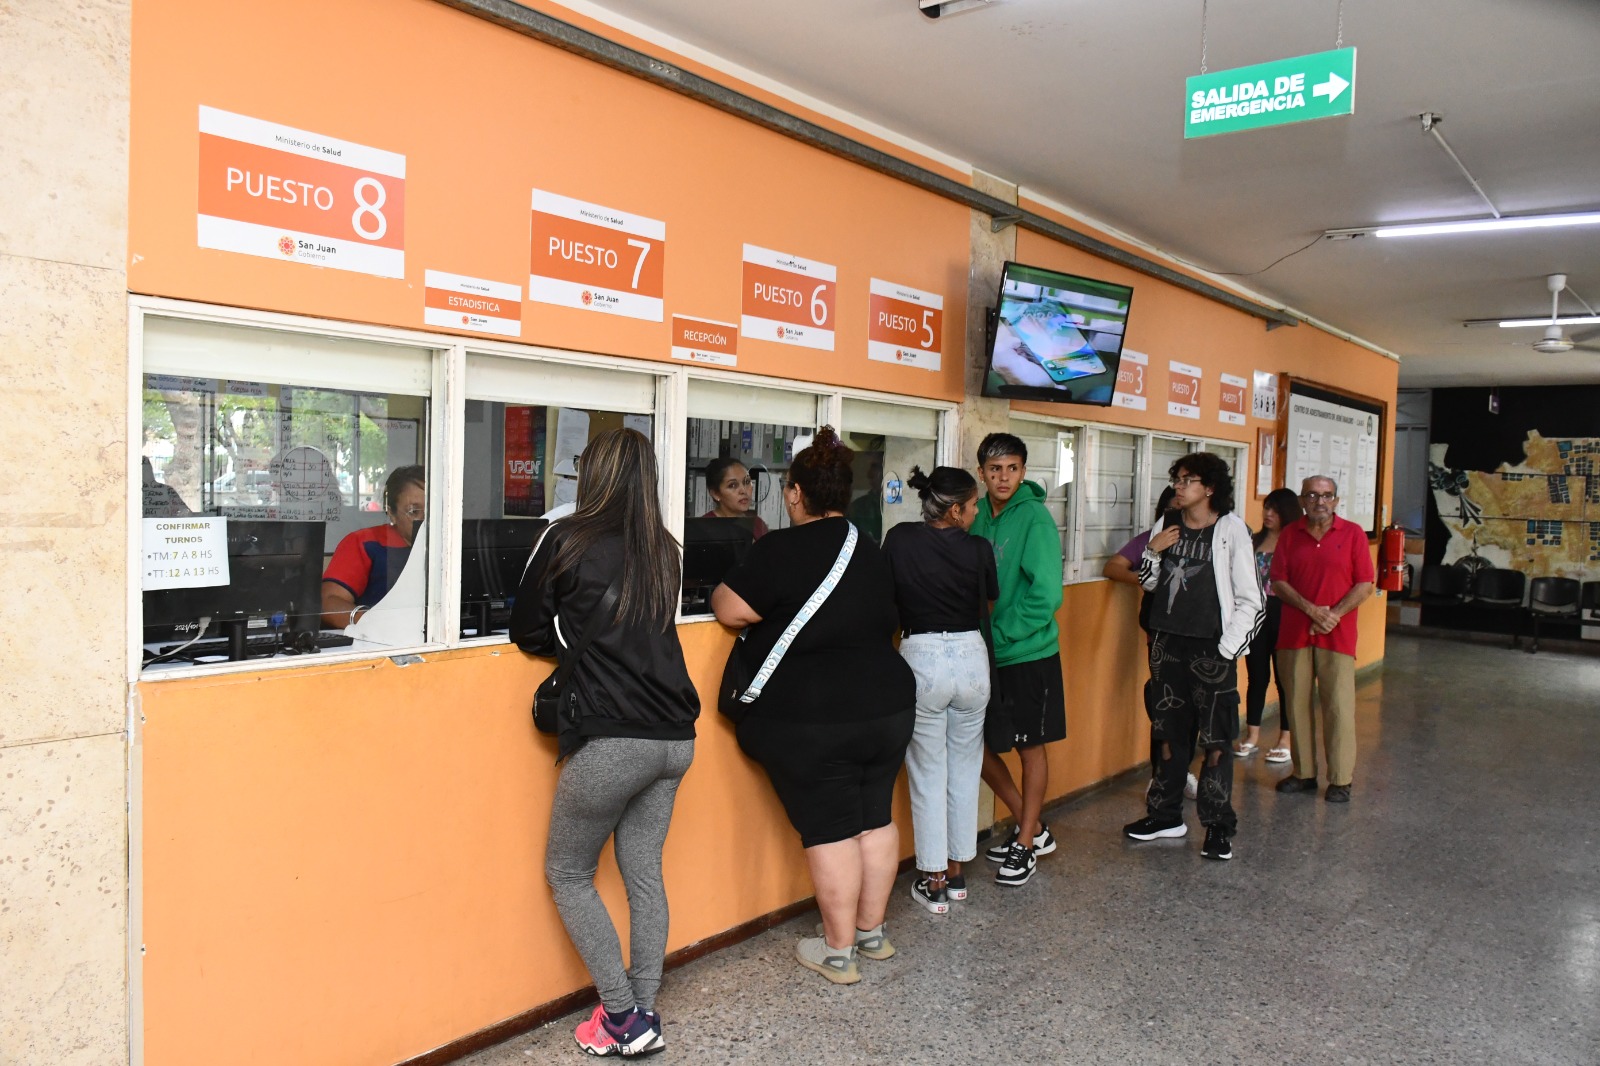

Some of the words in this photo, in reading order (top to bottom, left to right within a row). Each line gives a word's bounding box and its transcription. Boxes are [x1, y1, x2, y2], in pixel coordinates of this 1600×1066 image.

[1191, 79, 1269, 109] SALIDA
[1274, 73, 1305, 96] DE
[1190, 93, 1306, 124] EMERGENCIA
[275, 135, 310, 150] Ministerio
[311, 144, 321, 152] de
[322, 146, 342, 157] Salud
[226, 167, 334, 211] PUESTO
[352, 177, 387, 241] 8
[580, 209, 603, 221] Ministerio
[603, 215, 610, 223] de
[610, 217, 624, 226] Salud
[298, 240, 314, 250] San
[316, 243, 337, 254] Juan
[298, 250, 326, 261] Gobierno
[549, 236, 618, 269] PUESTO
[627, 238, 651, 289] 7
[448, 296, 500, 313] ESTADISTICA
[593, 301, 613, 309] Gobierno
[594, 293, 605, 301] San
[606, 295, 619, 303] Juan
[754, 282, 803, 308] PUESTO
[810, 284, 828, 326] 6
[684, 329, 727, 346] RECEPCIÓN
[879, 311, 917, 333] PUESTO
[920, 309, 934, 348] 5
[1117, 371, 1134, 384] UESTO
[1135, 365, 1143, 394] 3
[1172, 381, 1190, 396] PUESTO
[1190, 378, 1198, 405] 2
[1222, 392, 1238, 404] PUESTO
[1238, 389, 1243, 412] 1
[508, 460, 541, 474] UPCN
[156, 522, 211, 531] CONFIRMAR
[165, 536, 203, 544] TURNOS
[843, 527, 858, 555] LOVE
[181, 551, 189, 560] A
[191, 550, 198, 559] 8
[200, 549, 213, 559] HS
[183, 568, 191, 577] A
[193, 567, 205, 576] 13
[208, 566, 220, 575] HS
[827, 556, 848, 586] LOVE
[803, 585, 830, 617] LOVE
[777, 617, 805, 650] LOVE
[757, 651, 781, 684] LOVE
